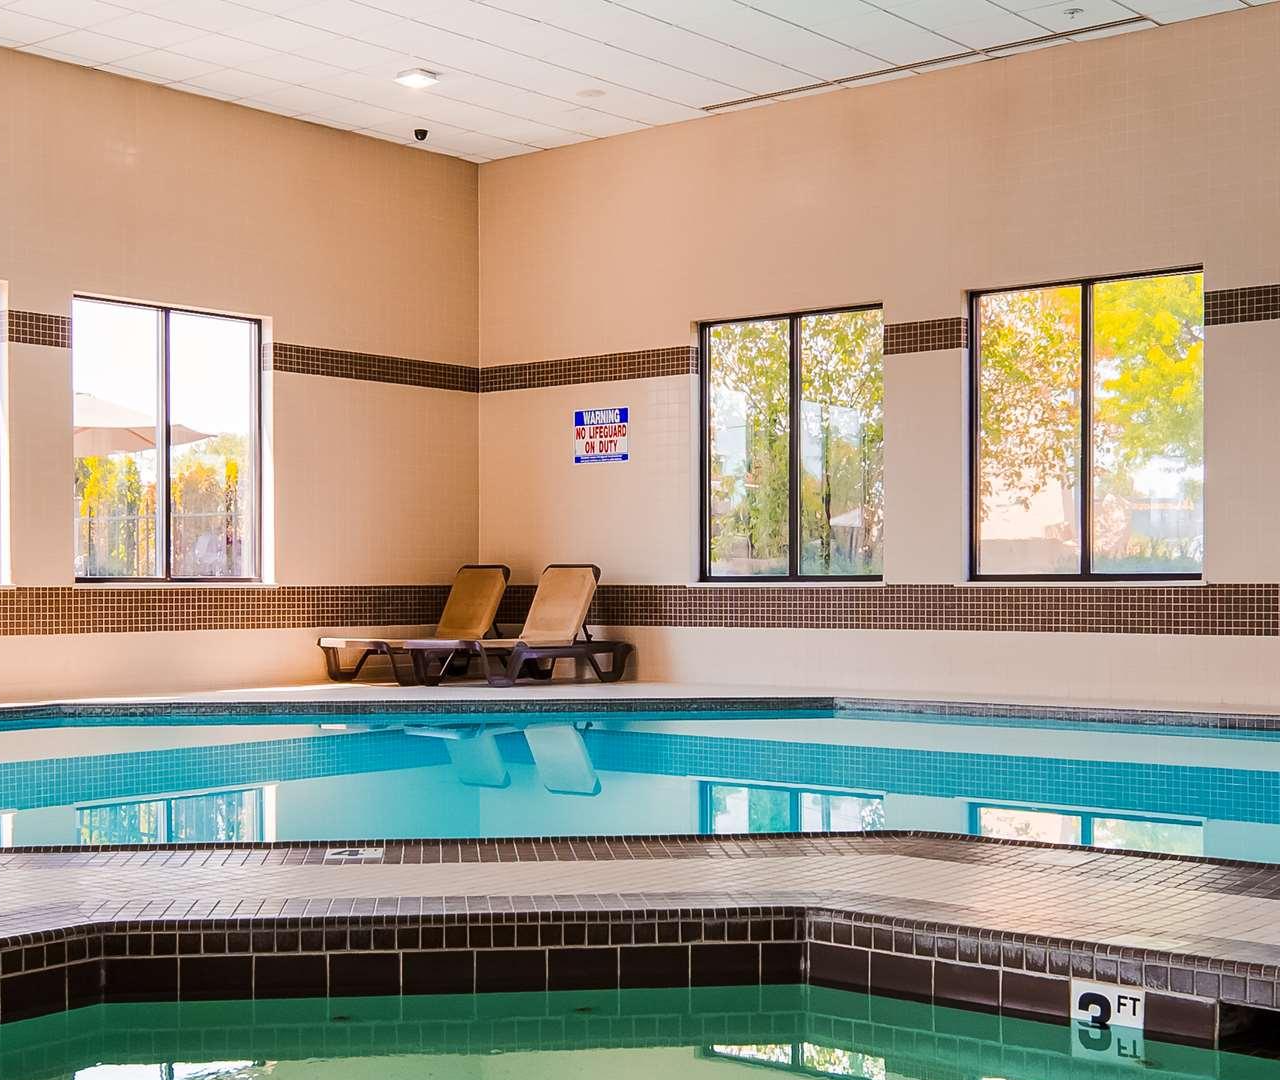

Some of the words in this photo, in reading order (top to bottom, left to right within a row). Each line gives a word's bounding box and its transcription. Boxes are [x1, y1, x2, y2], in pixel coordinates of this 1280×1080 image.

[582, 409, 621, 425] WARNING
[575, 427, 587, 440] NO
[588, 424, 627, 439] LIFEGUARD
[584, 441, 595, 454] ON
[598, 439, 618, 453] DUTY
[1078, 991, 1111, 1030] 3
[1117, 994, 1141, 1016] FT
